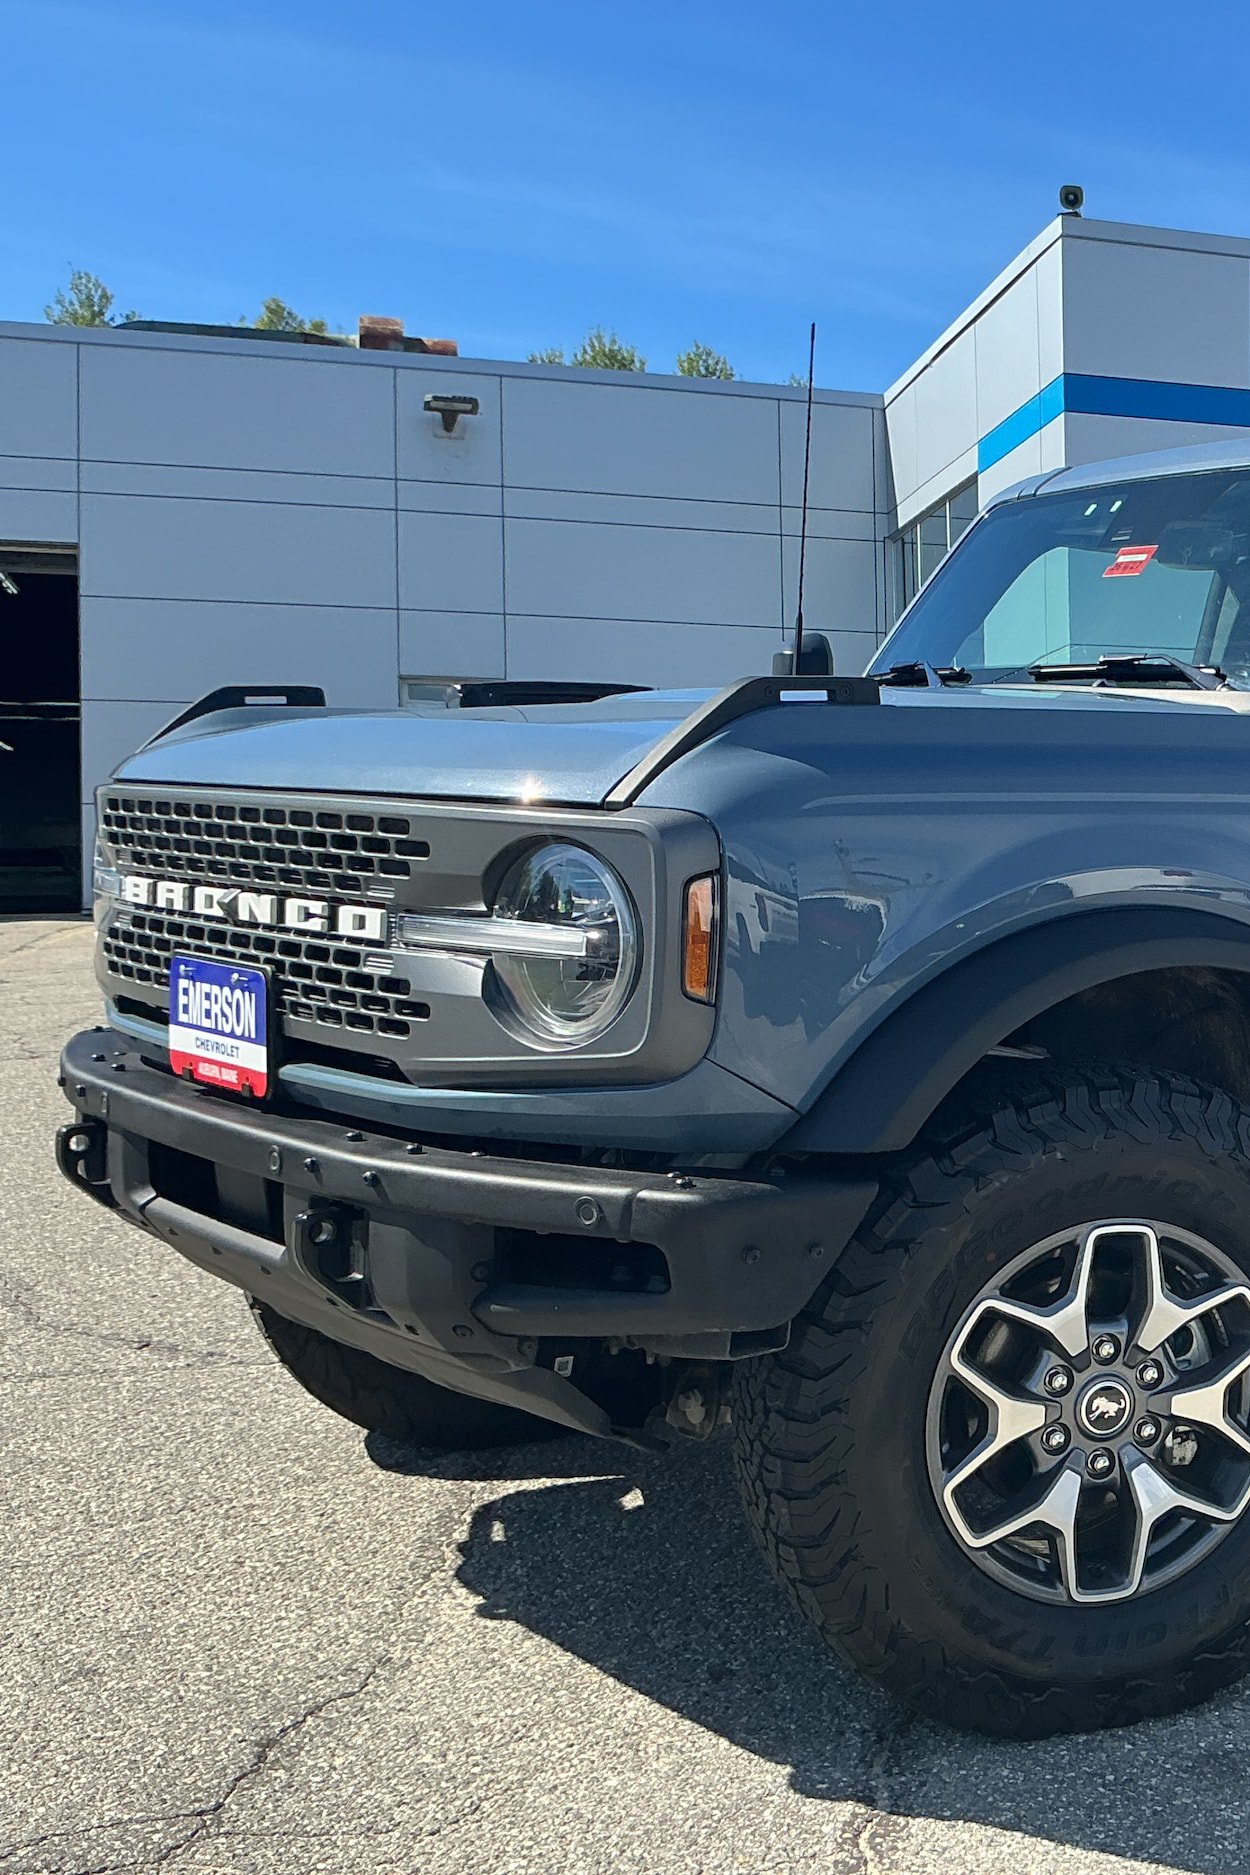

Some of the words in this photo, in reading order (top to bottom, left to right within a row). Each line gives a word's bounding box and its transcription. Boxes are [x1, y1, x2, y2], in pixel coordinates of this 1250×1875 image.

[124, 875, 388, 940] BRONCO
[177, 978, 257, 1039] EMERSON
[195, 1036, 240, 1059] CHEVROLET
